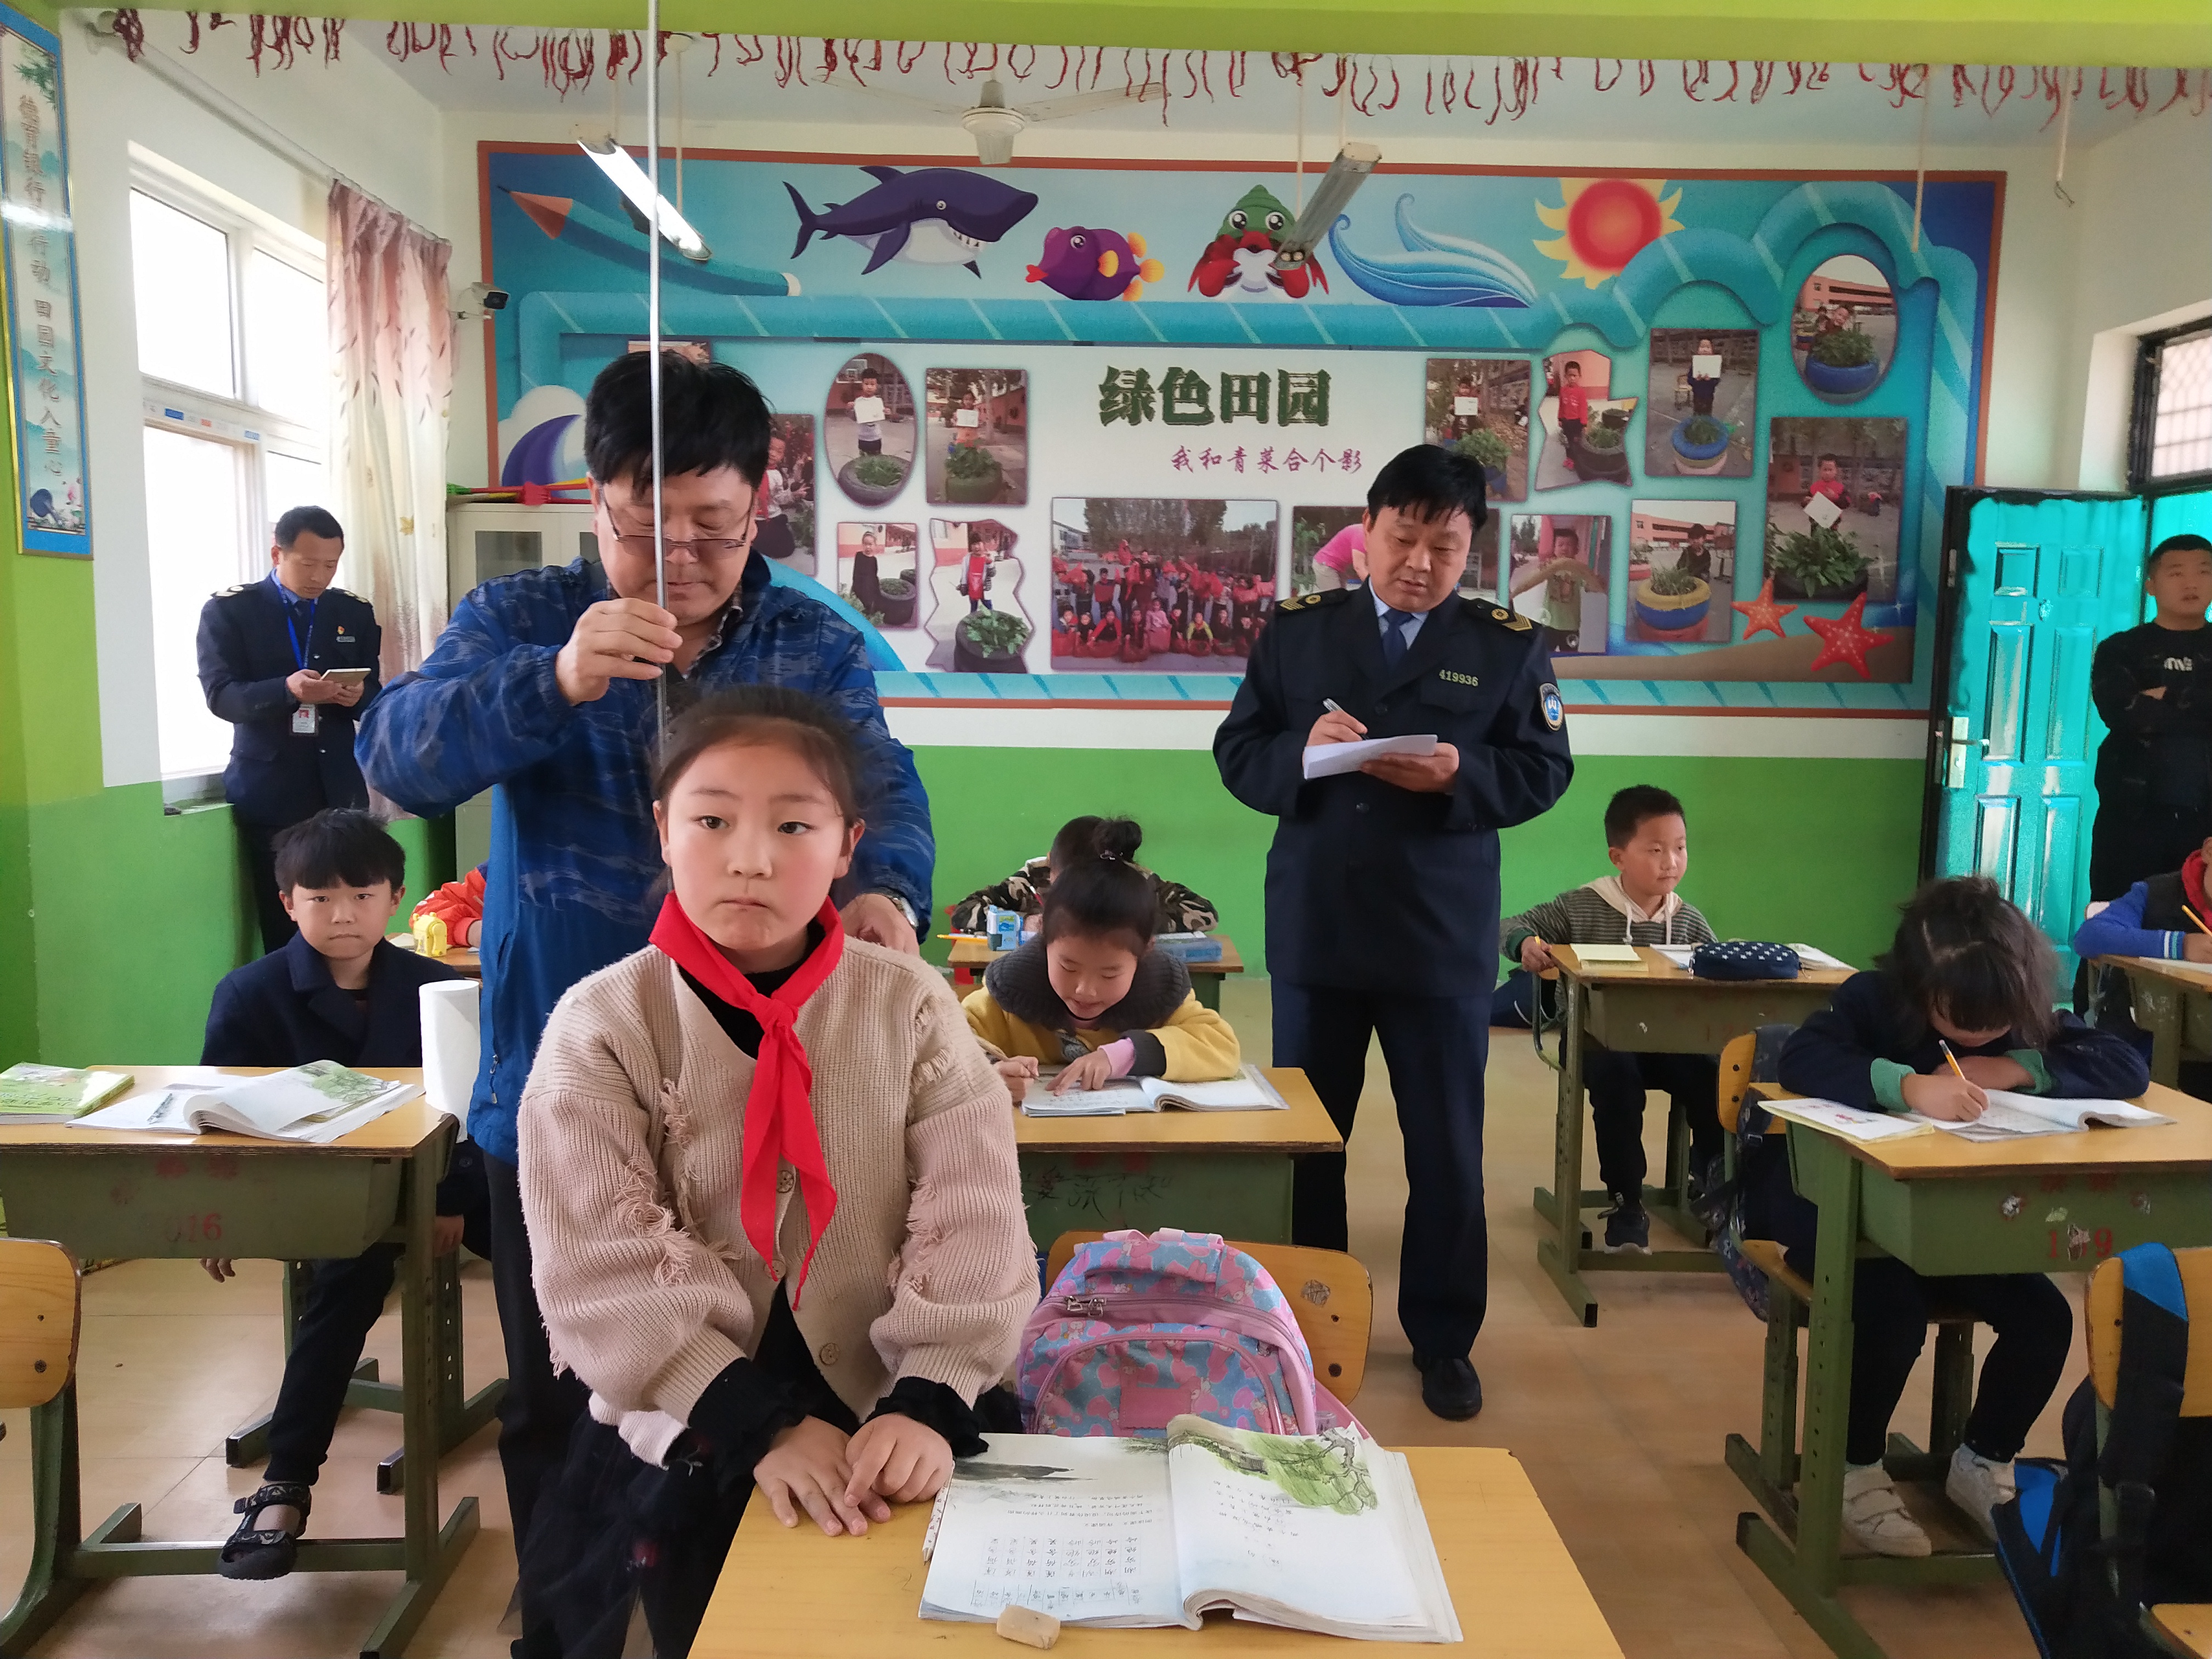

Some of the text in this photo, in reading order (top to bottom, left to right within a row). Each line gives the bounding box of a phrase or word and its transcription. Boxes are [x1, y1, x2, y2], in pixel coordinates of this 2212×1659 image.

[1098, 366, 1331, 427] 绿色田园
[1171, 445, 1363, 473] 我和青菜合个影
